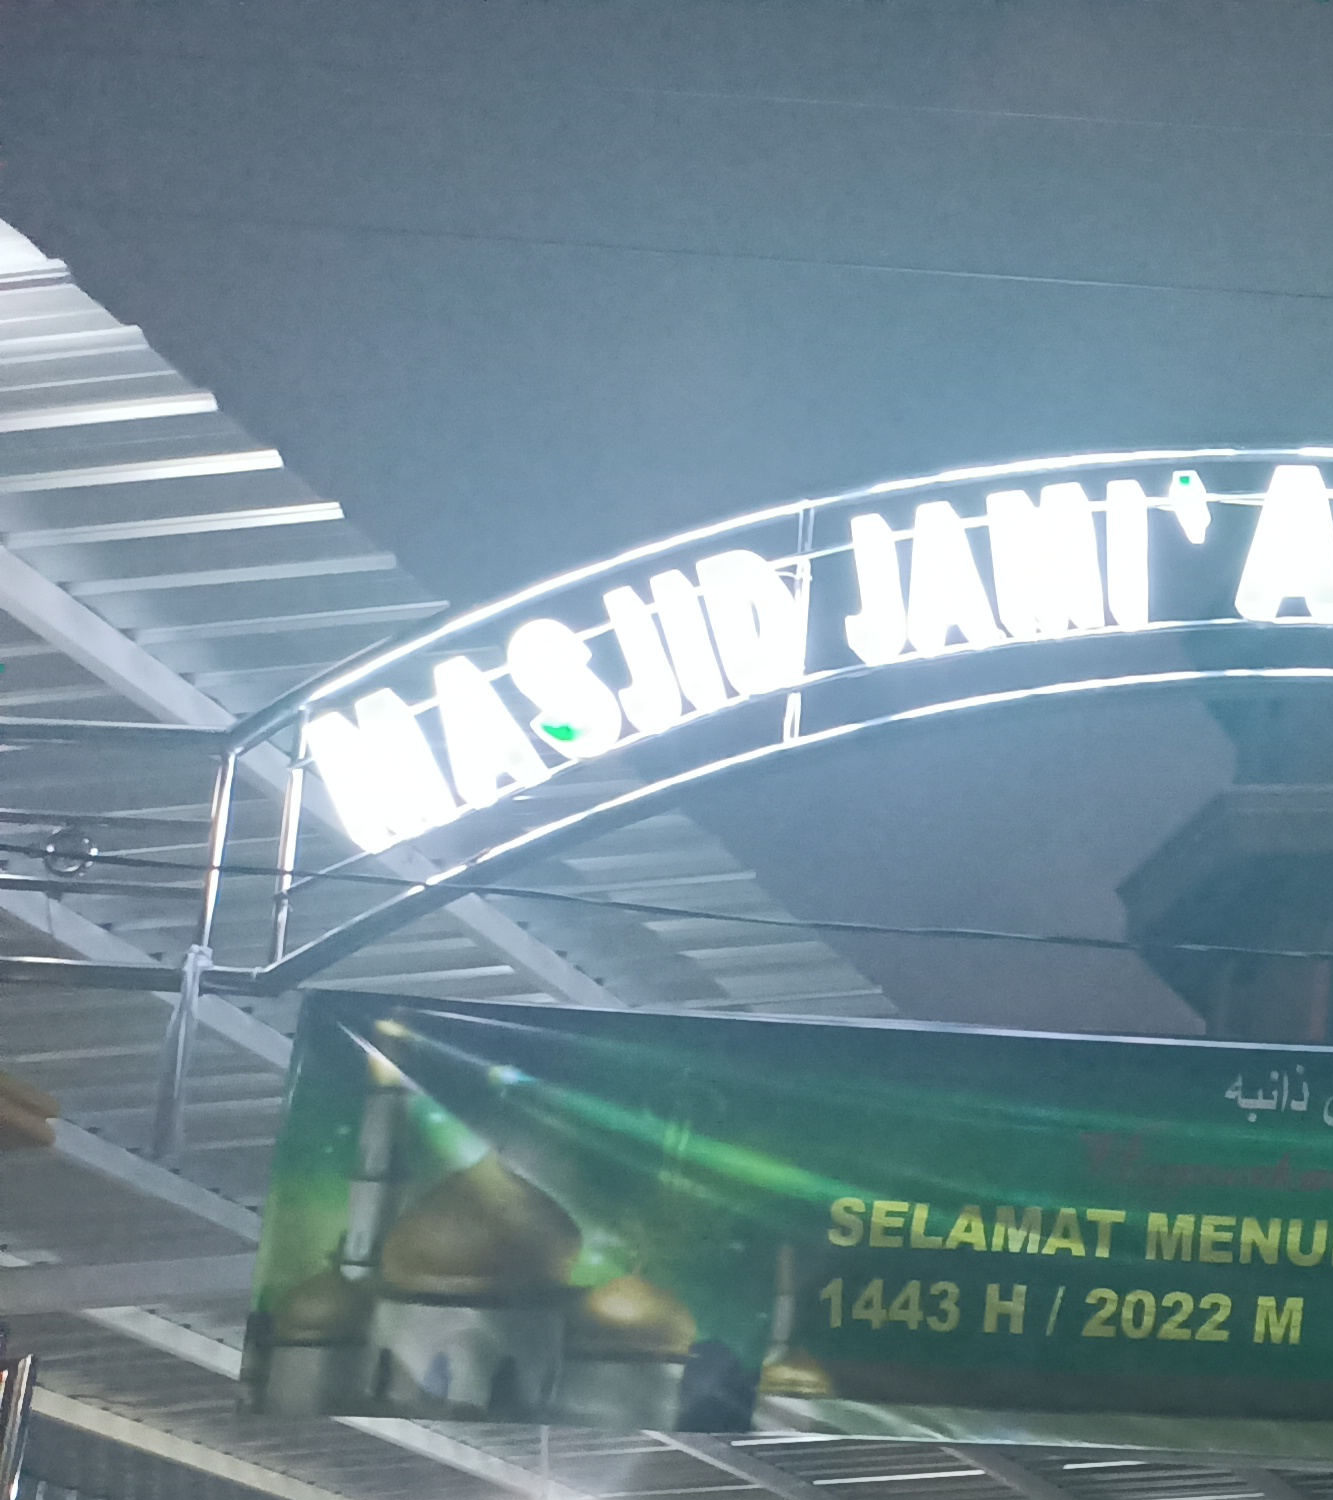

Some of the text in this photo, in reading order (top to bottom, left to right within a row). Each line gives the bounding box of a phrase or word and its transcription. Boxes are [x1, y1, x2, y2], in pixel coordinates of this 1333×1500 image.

[302, 550, 808, 853] MASJID
[827, 1199, 1125, 1260] SELAMAT
[819, 1277, 1306, 1347] 1443 H / 2022 M
